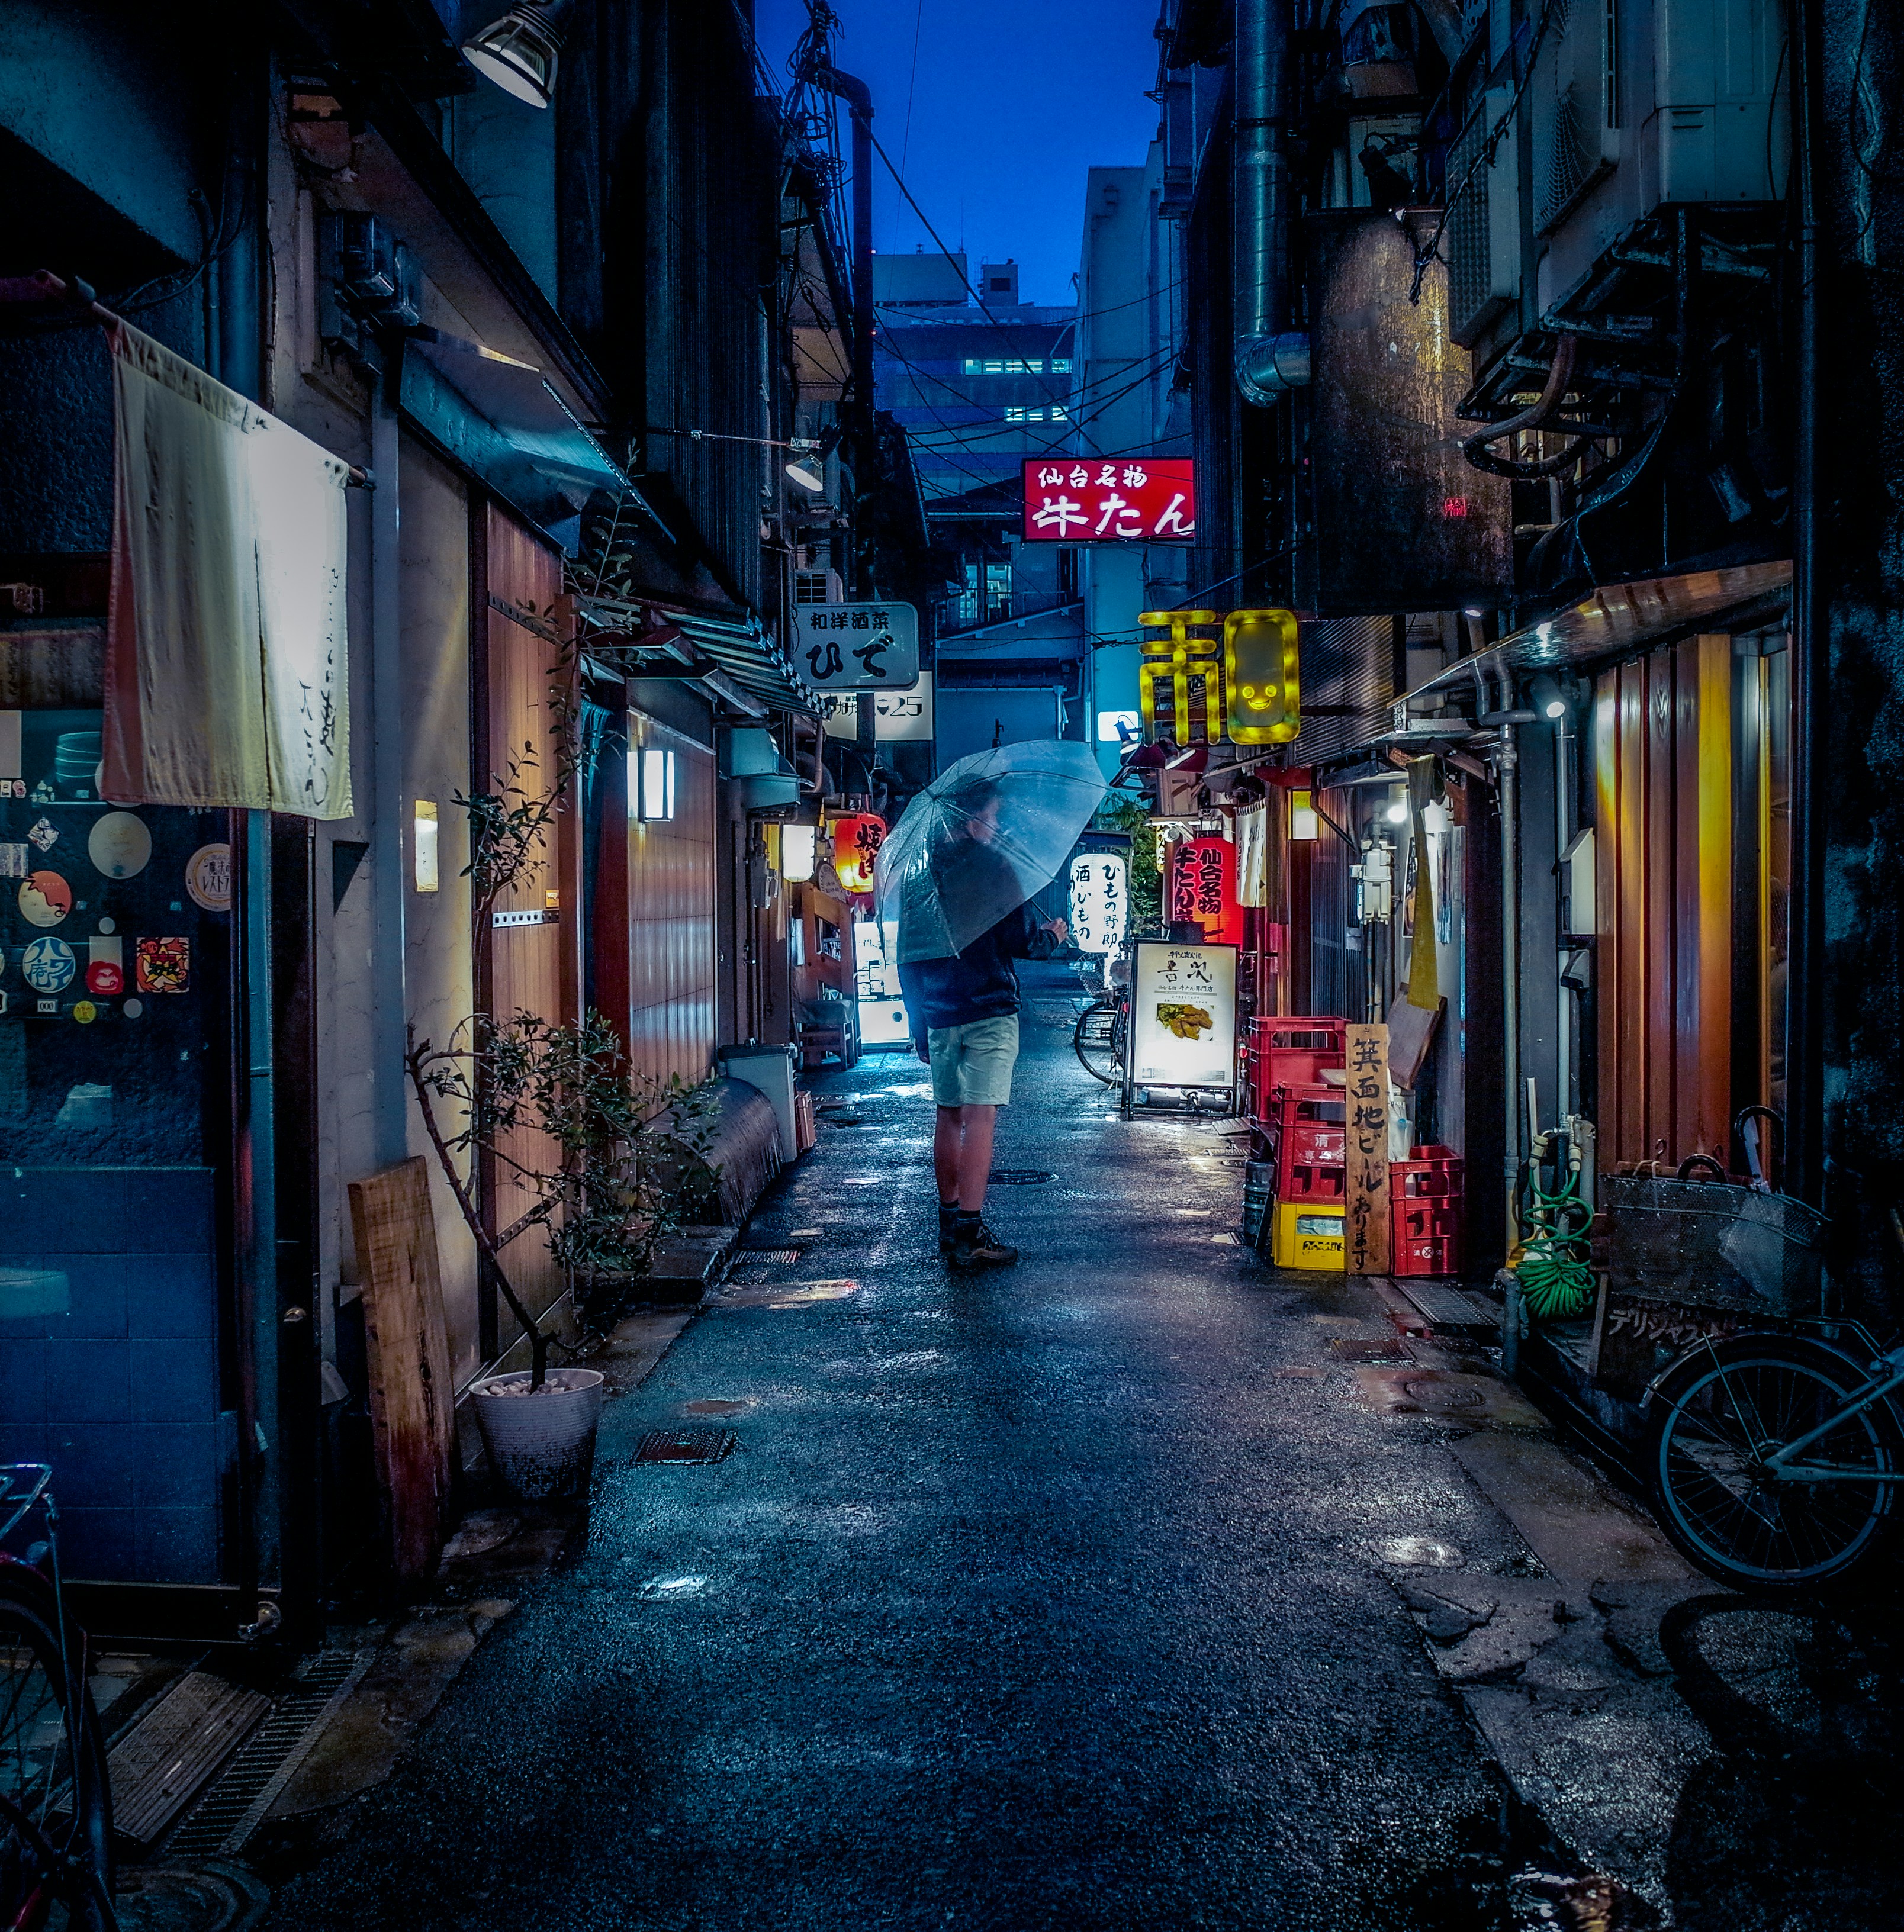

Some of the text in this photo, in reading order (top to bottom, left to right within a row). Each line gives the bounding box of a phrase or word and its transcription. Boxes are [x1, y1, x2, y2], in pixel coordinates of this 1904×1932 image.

[1038, 465, 1147, 488] 仙台名物
[1031, 493, 1195, 537] 牛たん
[811, 611, 889, 630] 和洋酒菜
[806, 635, 894, 680] ひで
[1198, 848, 1223, 915] 仙台名物
